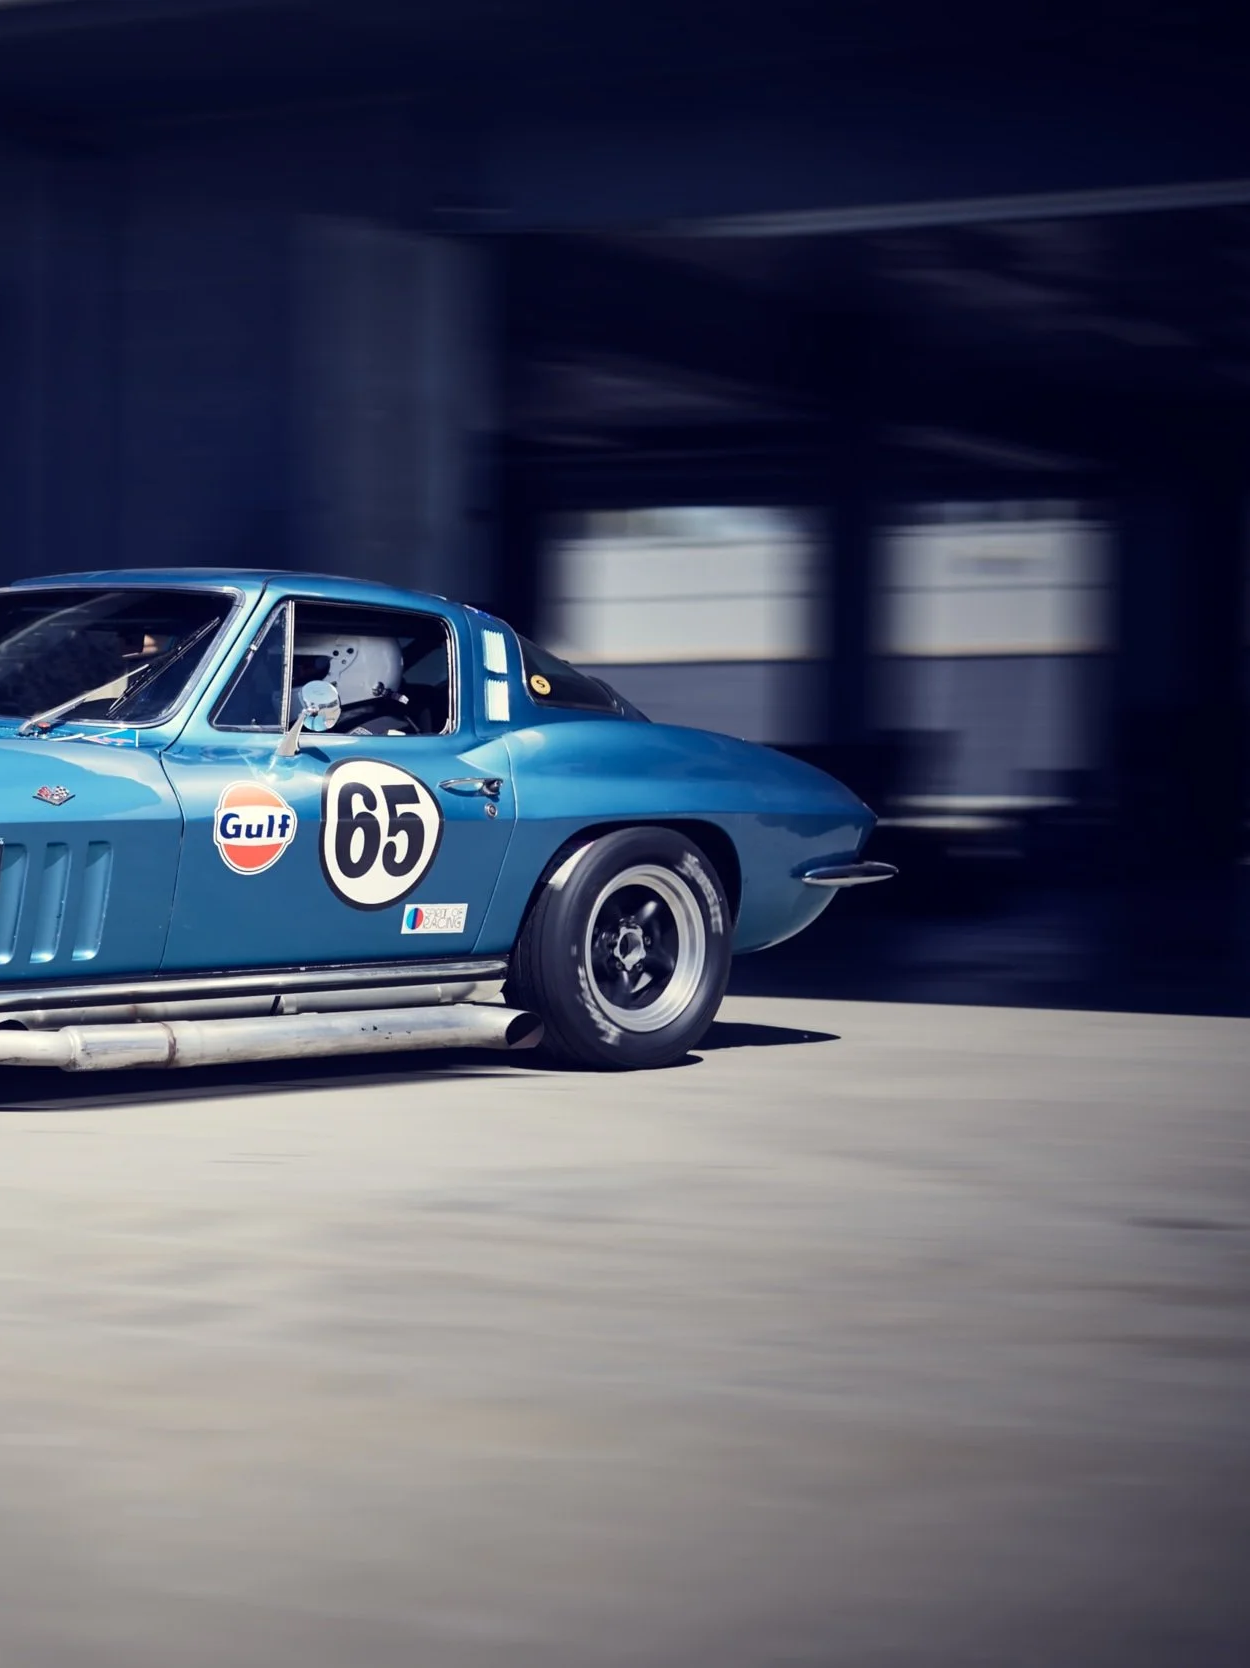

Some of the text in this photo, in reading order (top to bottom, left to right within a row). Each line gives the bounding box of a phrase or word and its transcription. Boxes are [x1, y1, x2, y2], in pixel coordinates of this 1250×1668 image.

[220, 812, 291, 839] Gulf
[335, 781, 425, 879] 65
[422, 917, 462, 929] RACING
